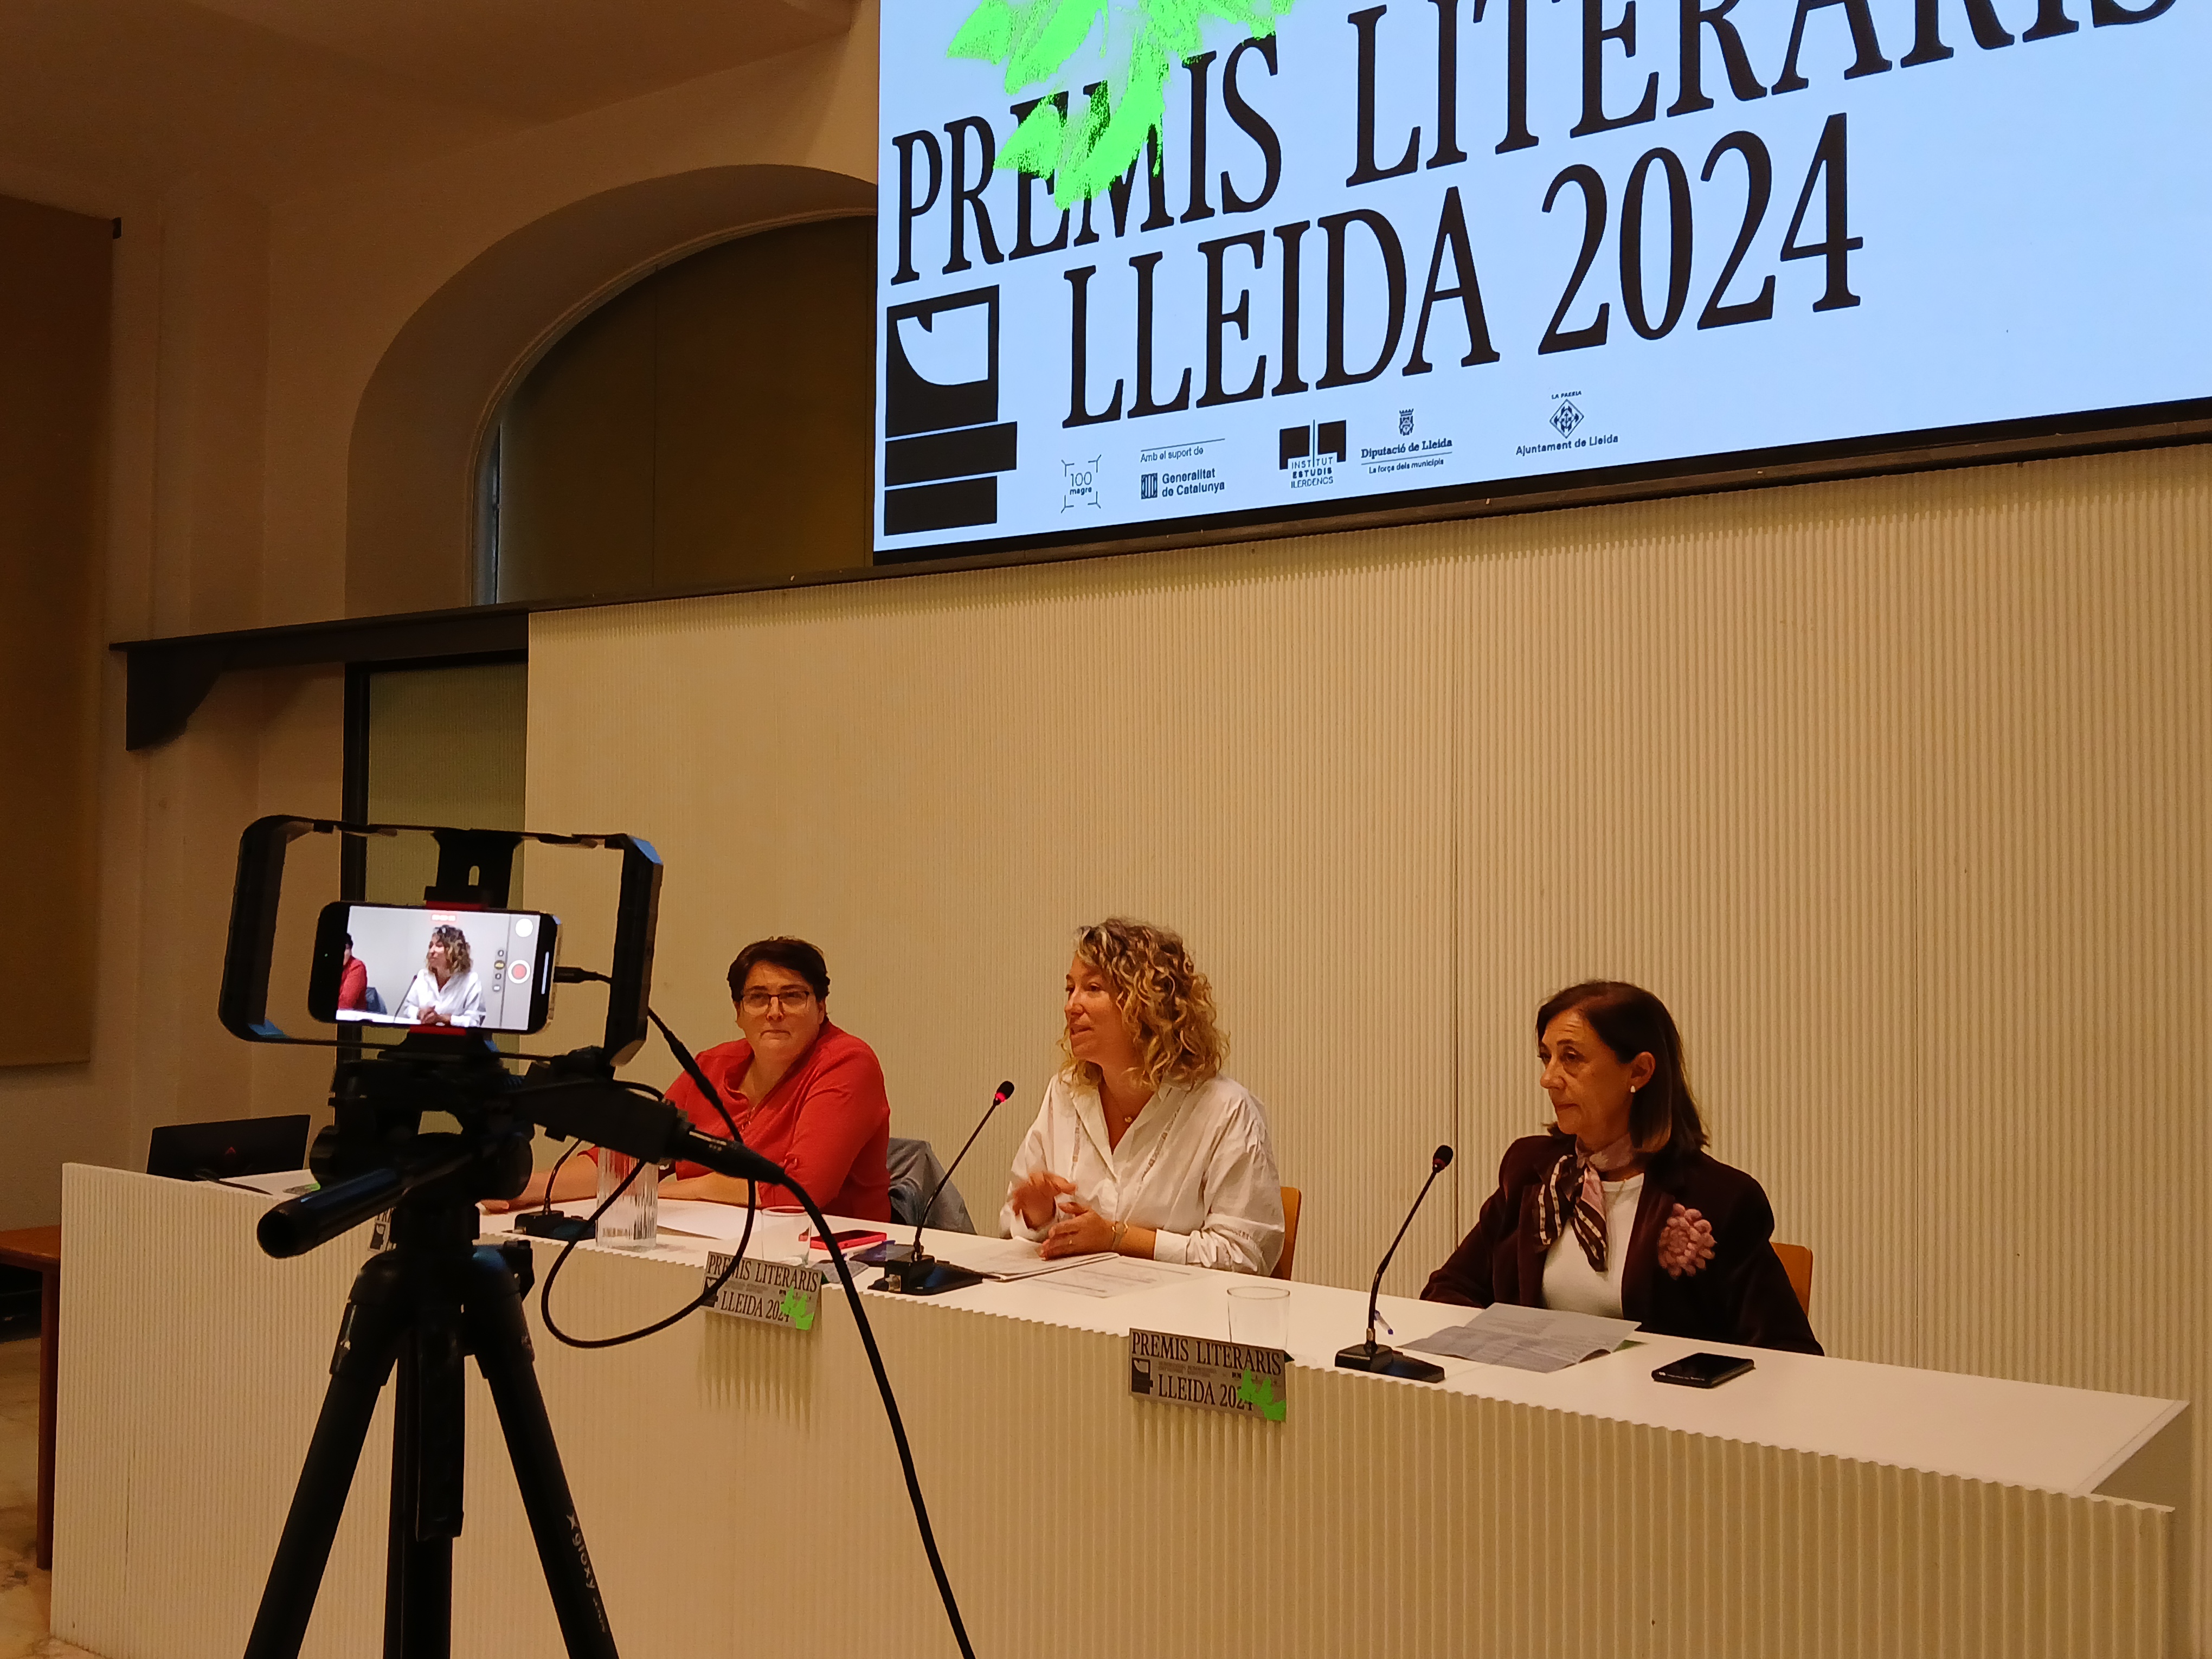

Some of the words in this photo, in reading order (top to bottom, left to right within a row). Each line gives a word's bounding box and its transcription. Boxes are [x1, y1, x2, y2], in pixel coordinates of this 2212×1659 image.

[1347, 0, 2177, 188] LITER
[1062, 186, 1500, 429] LLEIDA
[1538, 112, 1863, 355] 2024
[1140, 452, 1158, 463] Amb
[1159, 450, 1166, 460] el
[1168, 447, 1192, 460] suport
[1193, 446, 1204, 455] de
[1361, 443, 1406, 459] Diputació
[1408, 442, 1419, 452] de
[1422, 438, 1452, 450] Lleida
[1516, 441, 1572, 456] Ajuntament
[1574, 438, 1586, 448] de
[1589, 434, 1618, 446] Lleida
[1291, 456, 1333, 470] INSTITUT
[1397, 462, 1410, 470] dels
[1411, 458, 1444, 468] municipis
[1070, 472, 1092, 487] 100
[1162, 468, 1216, 484] Generalitat
[1291, 476, 1333, 488] ILERDENCS
[1293, 467, 1332, 479] ESTUDIS
[1162, 486, 1174, 497] de
[1176, 482, 1225, 496] Catalunya
[754, 1262, 819, 1293] LITERARIS
[721, 1291, 763, 1317] LLEIDA
[1131, 1331, 1189, 1362] PREMIS
[1196, 1340, 1282, 1375] LITERARIS
[1158, 1373, 1216, 1405] LLEIDA
